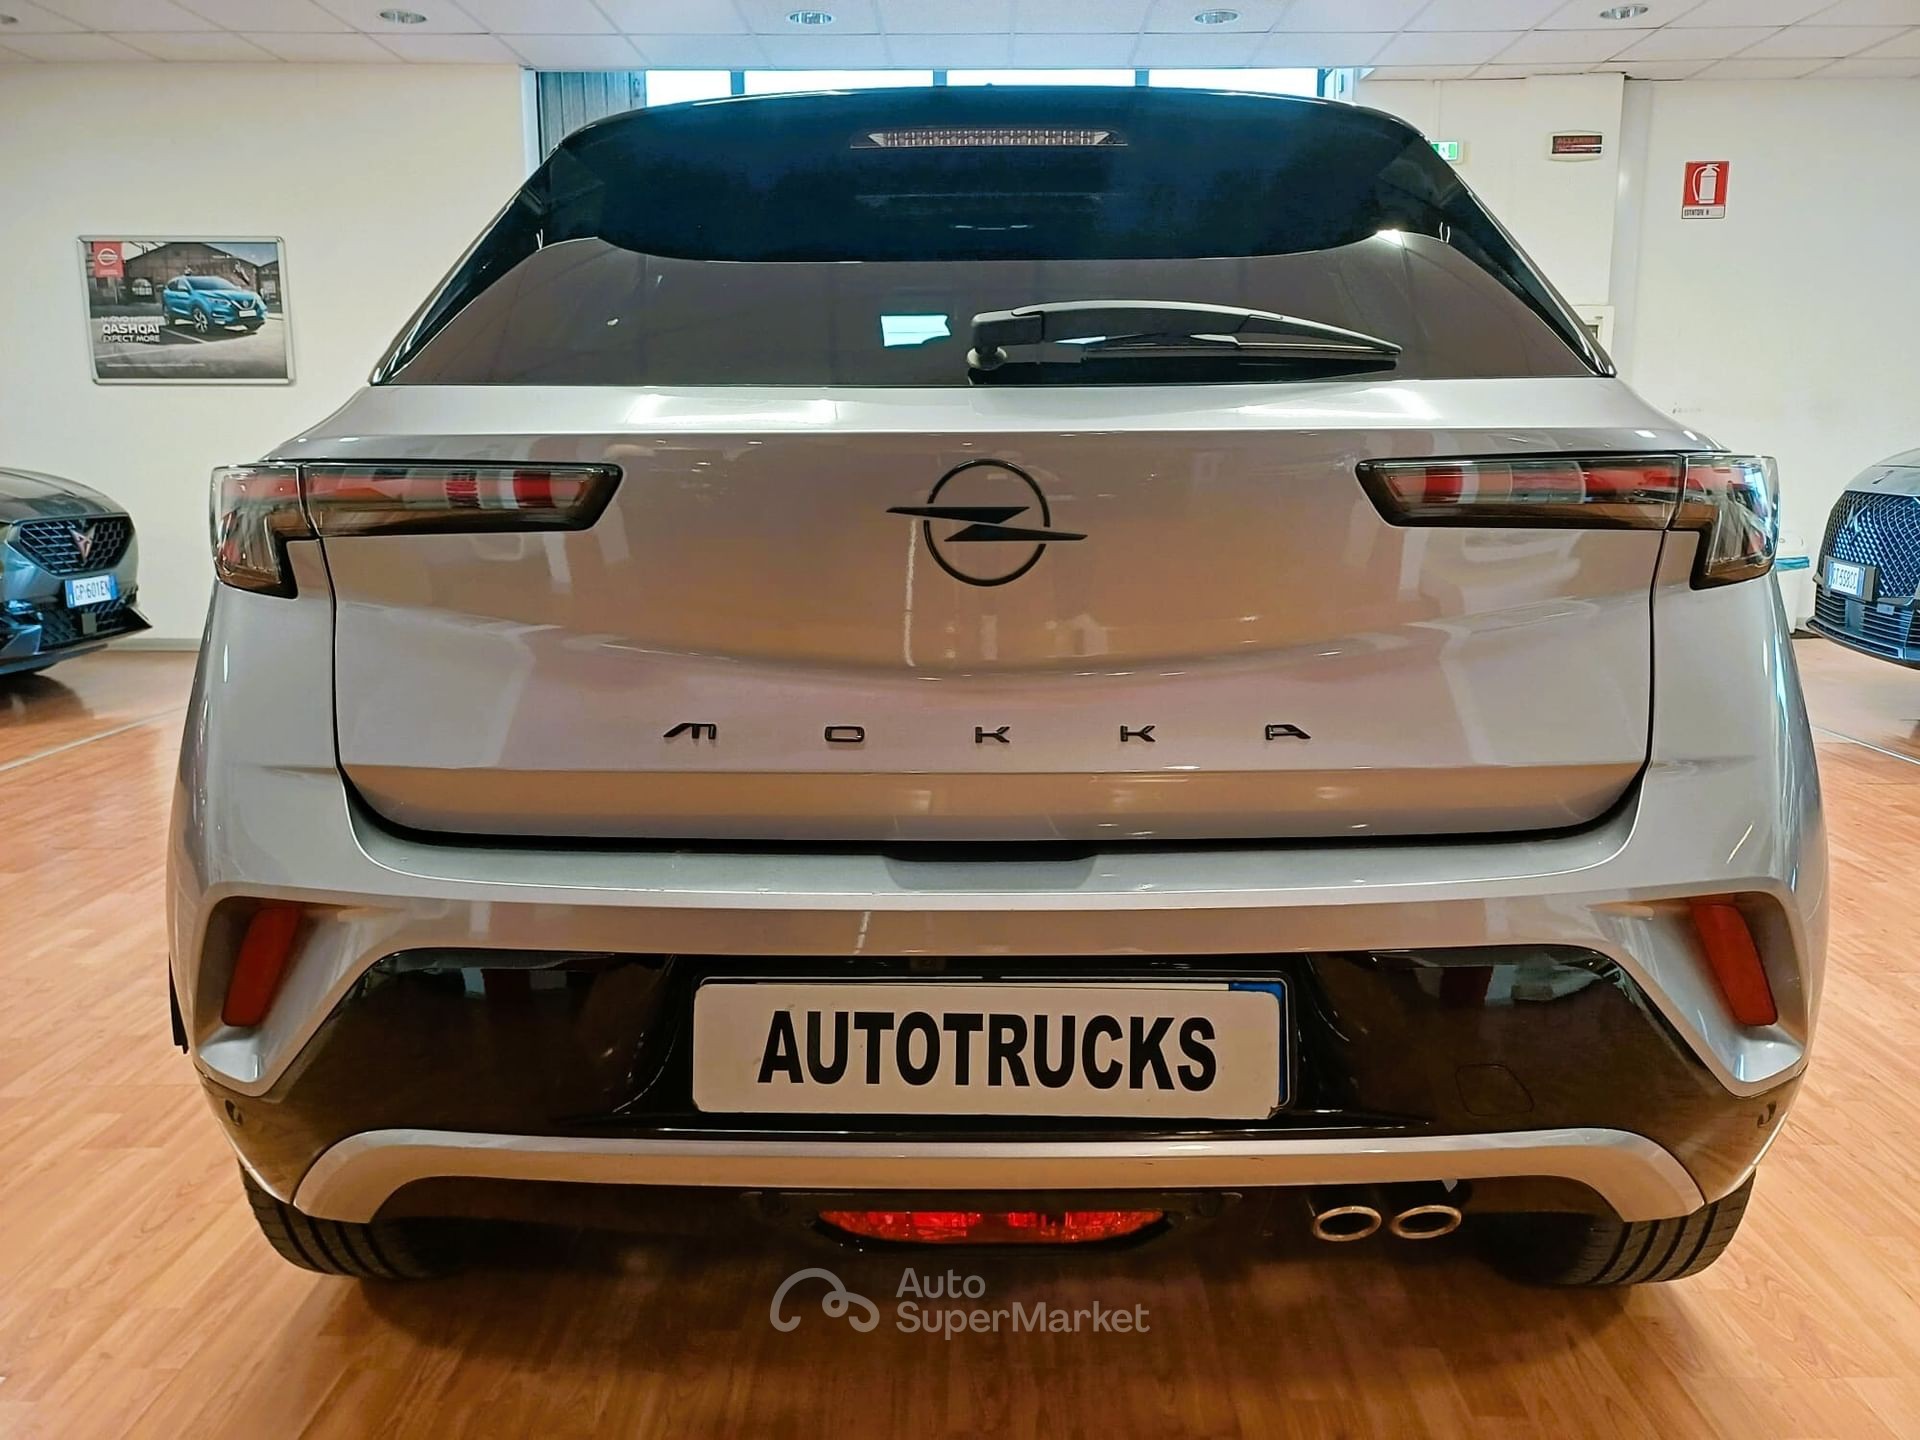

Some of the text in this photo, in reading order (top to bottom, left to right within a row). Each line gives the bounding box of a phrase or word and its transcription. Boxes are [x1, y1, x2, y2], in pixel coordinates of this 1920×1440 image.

[102, 323, 160, 334] QASHQAI
[103, 334, 160, 343] EXPECT MORE
[663, 722, 1311, 744] MOKKA
[757, 1010, 1217, 1092] AUTOTRUCKS
